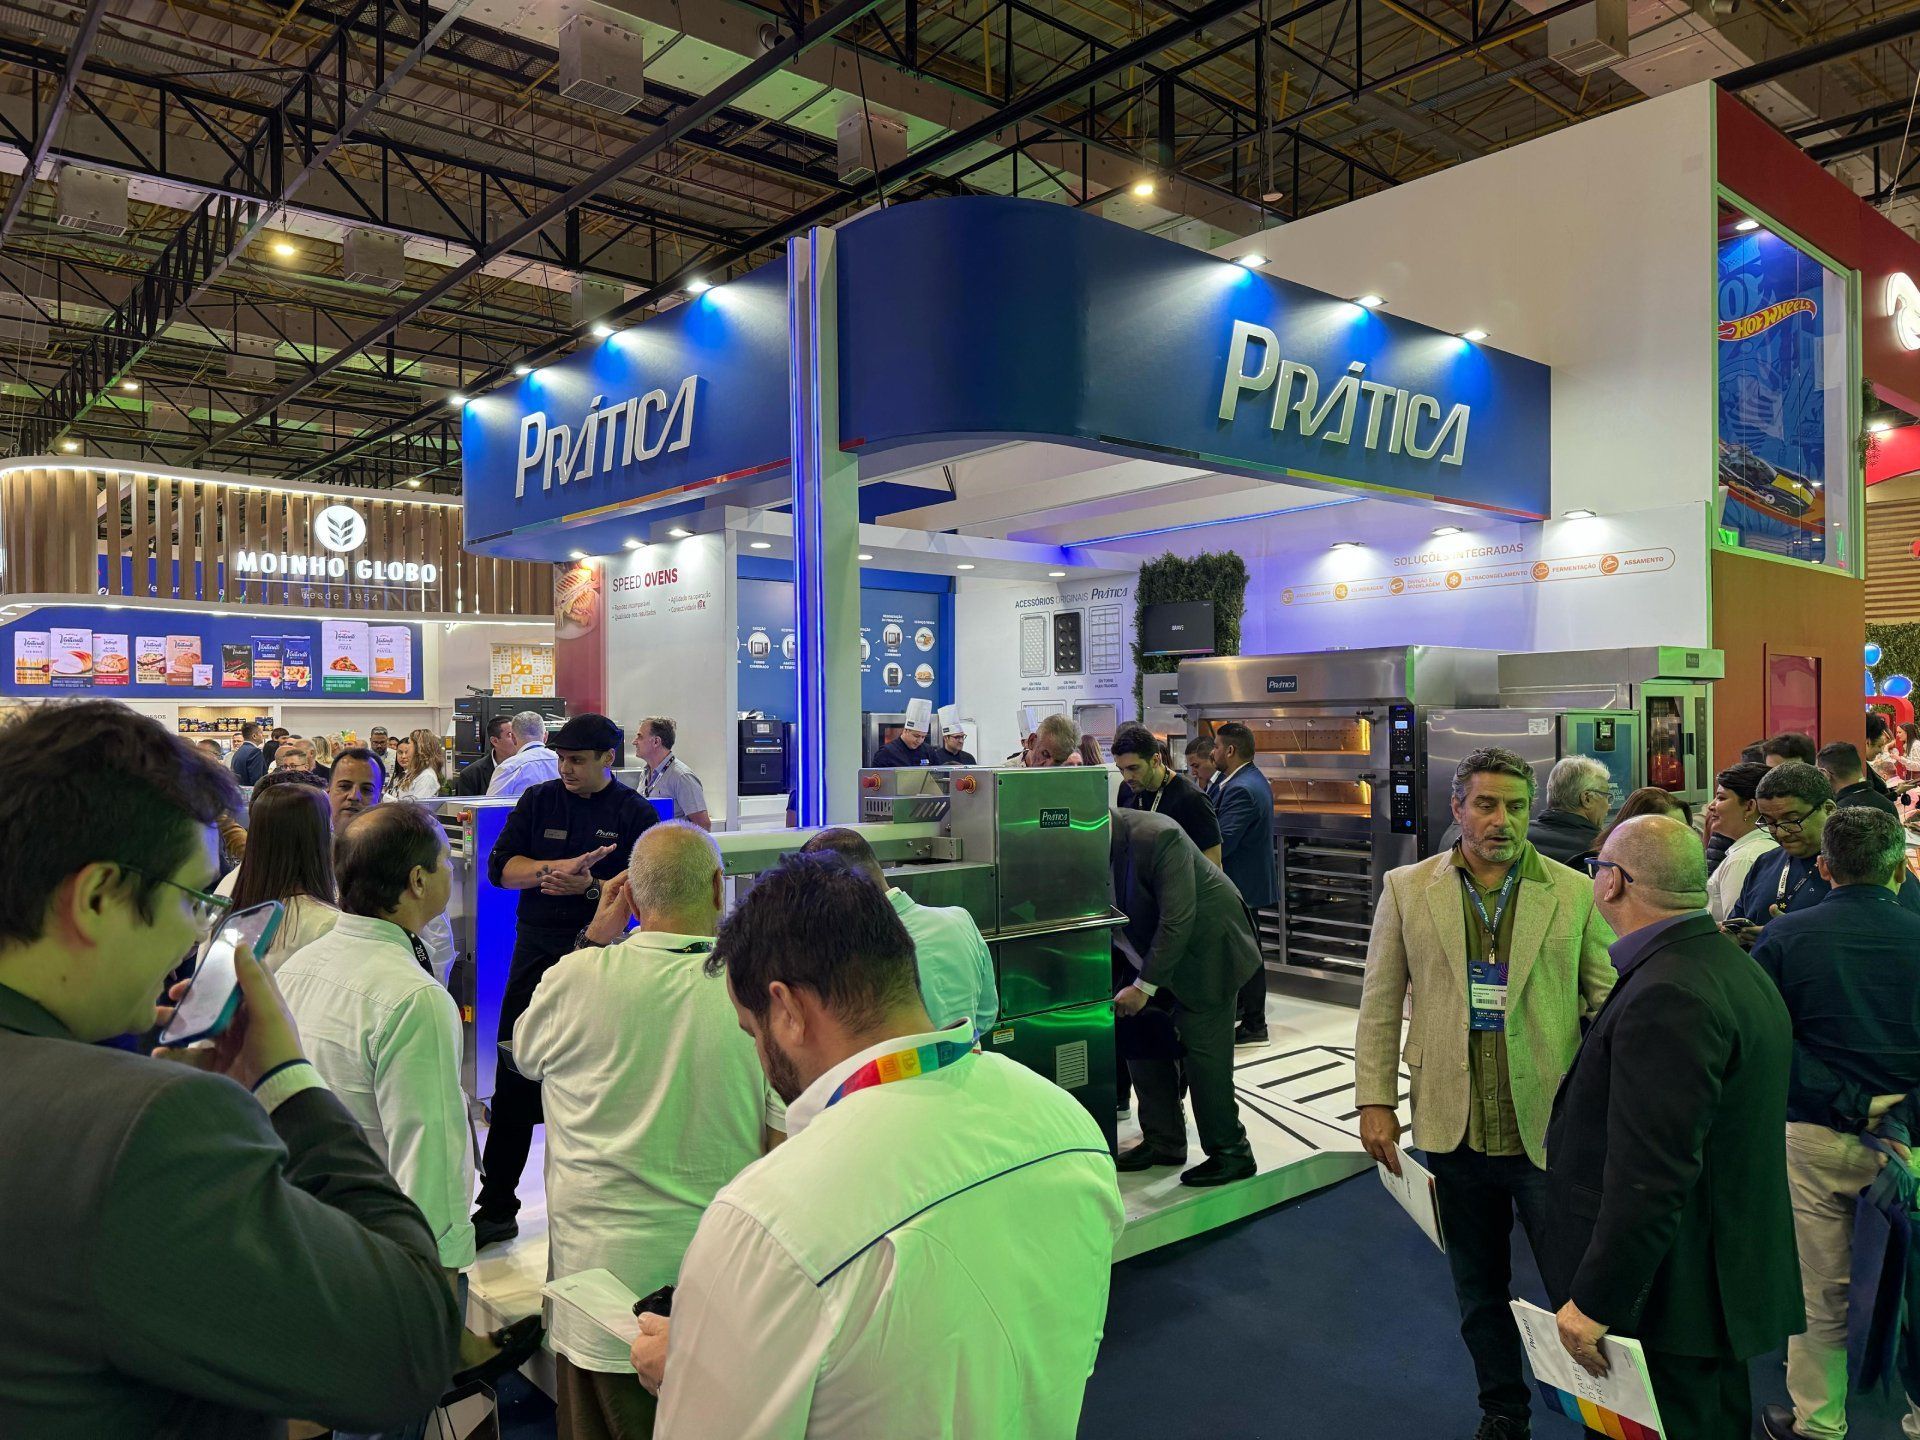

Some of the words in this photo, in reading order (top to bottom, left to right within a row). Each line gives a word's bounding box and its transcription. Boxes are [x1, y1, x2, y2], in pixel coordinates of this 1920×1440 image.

[1734, 313, 1764, 339] HOT
[1394, 552, 1449, 566] SOLUÇÕES
[1451, 543, 1524, 559] INTEGRADAS
[1624, 555, 1664, 566] ASSAMENTO
[236, 550, 345, 578] MOINHO
[356, 558, 437, 583] GLOBO
[1552, 563, 1596, 573] FERMENTAÇÃO
[613, 575, 642, 592] SPEED
[644, 567, 678, 588] OVENS
[347, 593, 379, 602] 1954
[1015, 596, 1055, 609] ACESSÓRIOS
[1056, 592, 1089, 604] ORIGINAIS
[415, 944, 427, 962] 2025
